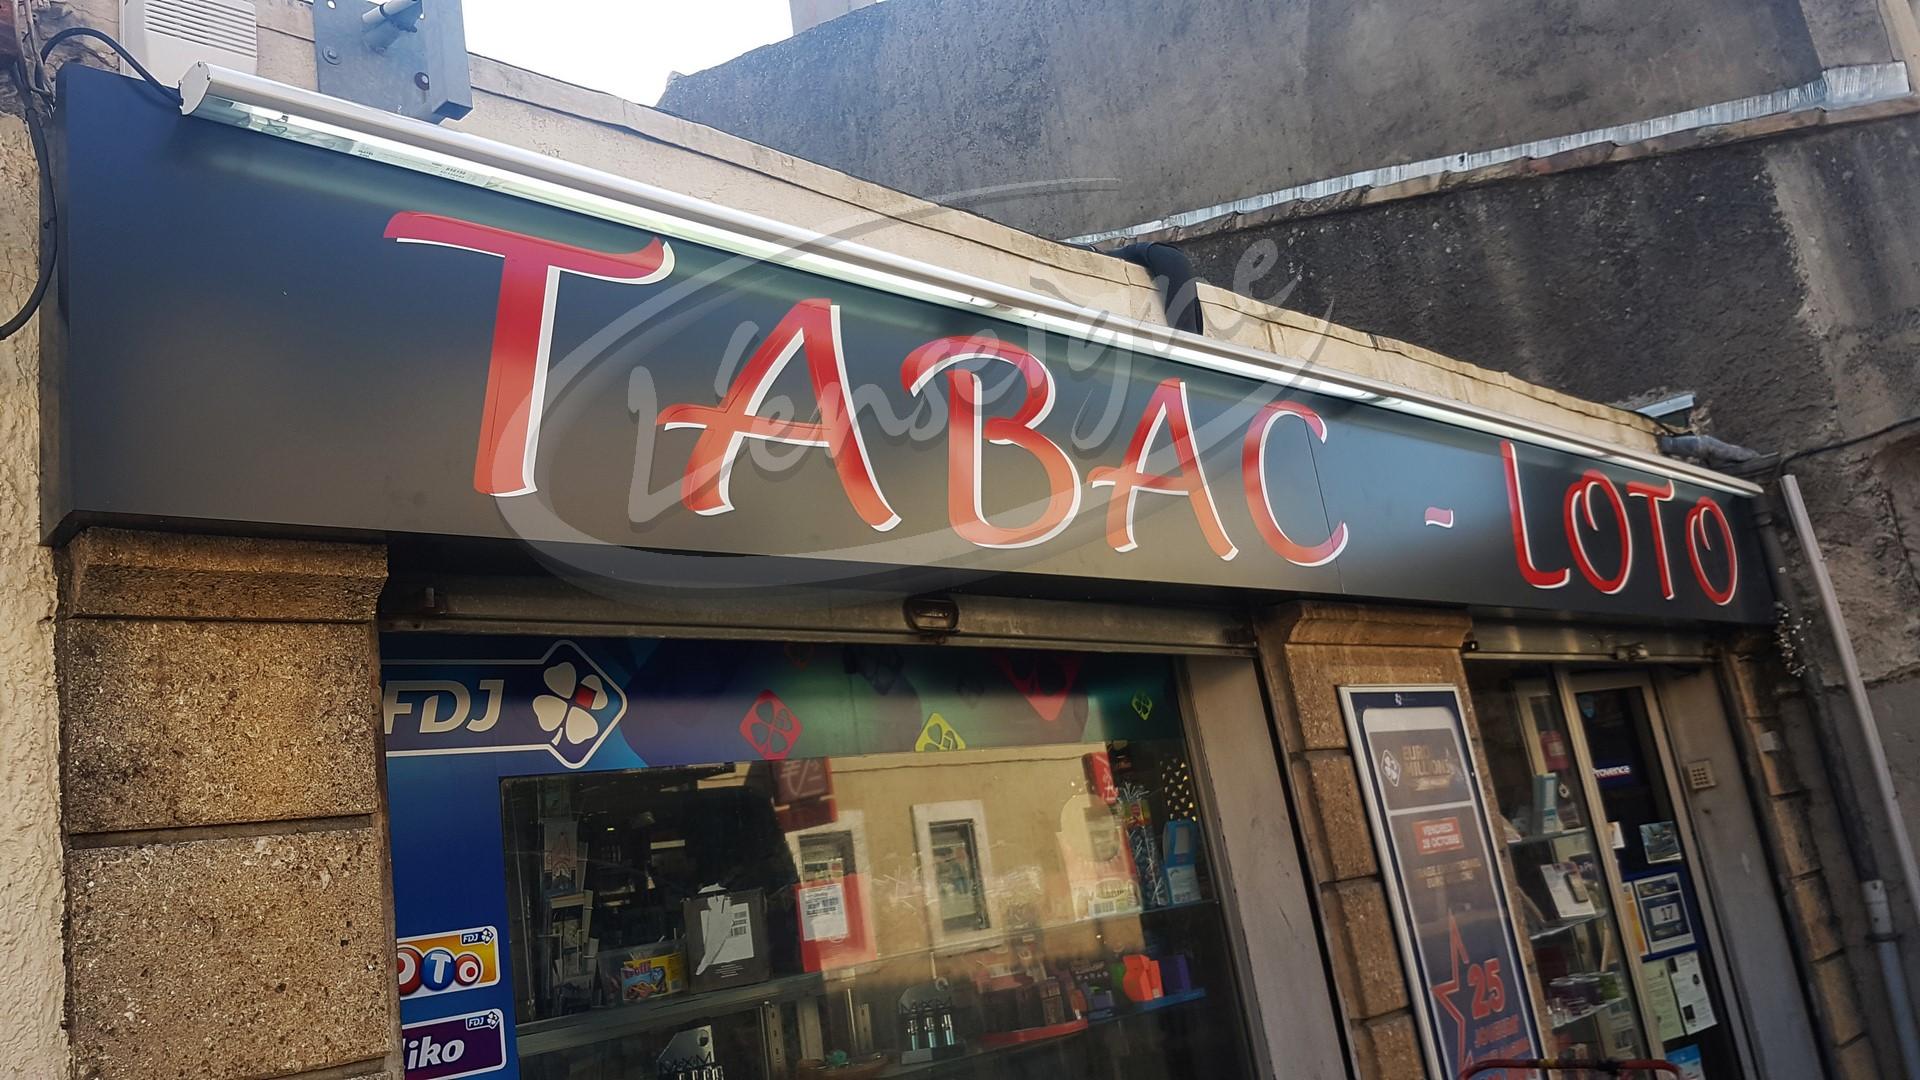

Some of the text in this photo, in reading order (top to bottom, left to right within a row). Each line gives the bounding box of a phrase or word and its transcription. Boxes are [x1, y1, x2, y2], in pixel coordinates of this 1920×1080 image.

[383, 211, 1348, 567] TABAC
[1500, 439, 1738, 605] LOTO
[384, 679, 504, 734] FDJ
[462, 933, 479, 944] FDJ
[1467, 958, 1505, 1019] 25
[468, 1017, 485, 1027] FDJ
[402, 1036, 465, 1070] iko
